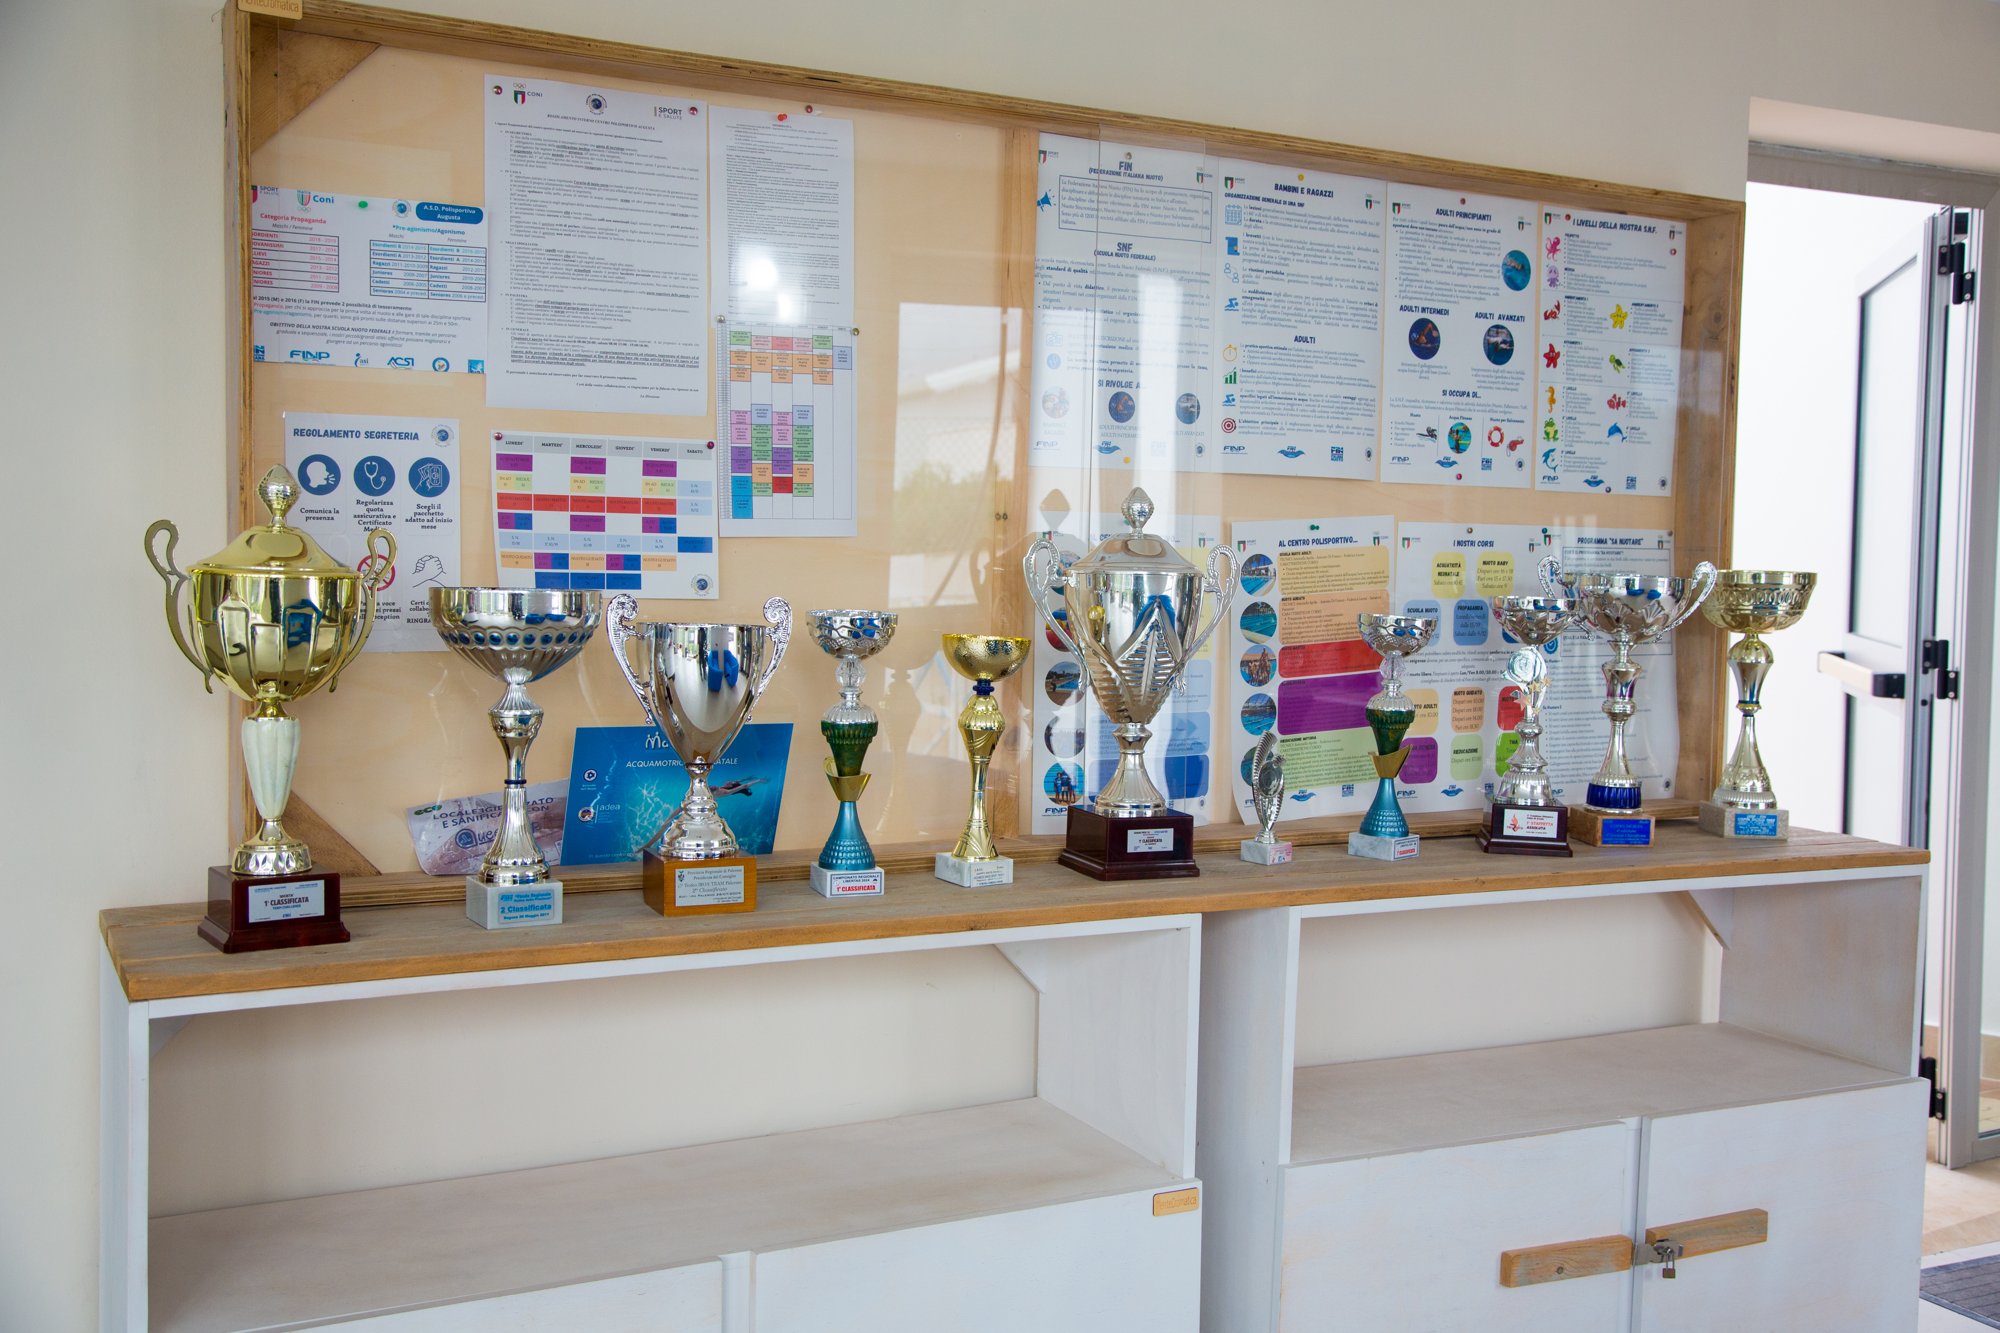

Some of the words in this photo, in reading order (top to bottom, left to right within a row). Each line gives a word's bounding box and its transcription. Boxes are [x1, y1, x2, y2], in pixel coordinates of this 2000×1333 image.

[658, 106, 682, 116] SPORT
[1119, 161, 1133, 171] FIN
[1274, 183, 1299, 193] BAMBINI
[1307, 188, 1334, 198] RAGAZZI
[313, 195, 335, 204] Coni
[290, 216, 326, 224] Propaganda
[1436, 208, 1454, 217] ADULTI
[1456, 211, 1492, 222] PRINCIPIANTI
[1619, 223, 1642, 232] NOSTRA
[1117, 242, 1133, 251] SNF
[1400, 305, 1419, 313] ADULTI
[1421, 307, 1450, 316] INTERMEDI
[1475, 312, 1494, 320] ADULTI
[1498, 314, 1525, 322] AVANZATI
[1294, 335, 1316, 344] ADULTI
[290, 350, 330, 361] FINP
[1105, 380, 1133, 389] RIVOLGE
[1449, 391, 1470, 400] OCCUPA
[293, 428, 361, 438] REGOLAMENTO
[364, 431, 419, 441] SEGRETERIA
[1287, 538, 1310, 547] CENTRO
[452, 811, 504, 826] SANIFICA
[271, 897, 309, 906] CLASSIFICATA
[508, 903, 552, 913] Classificata
